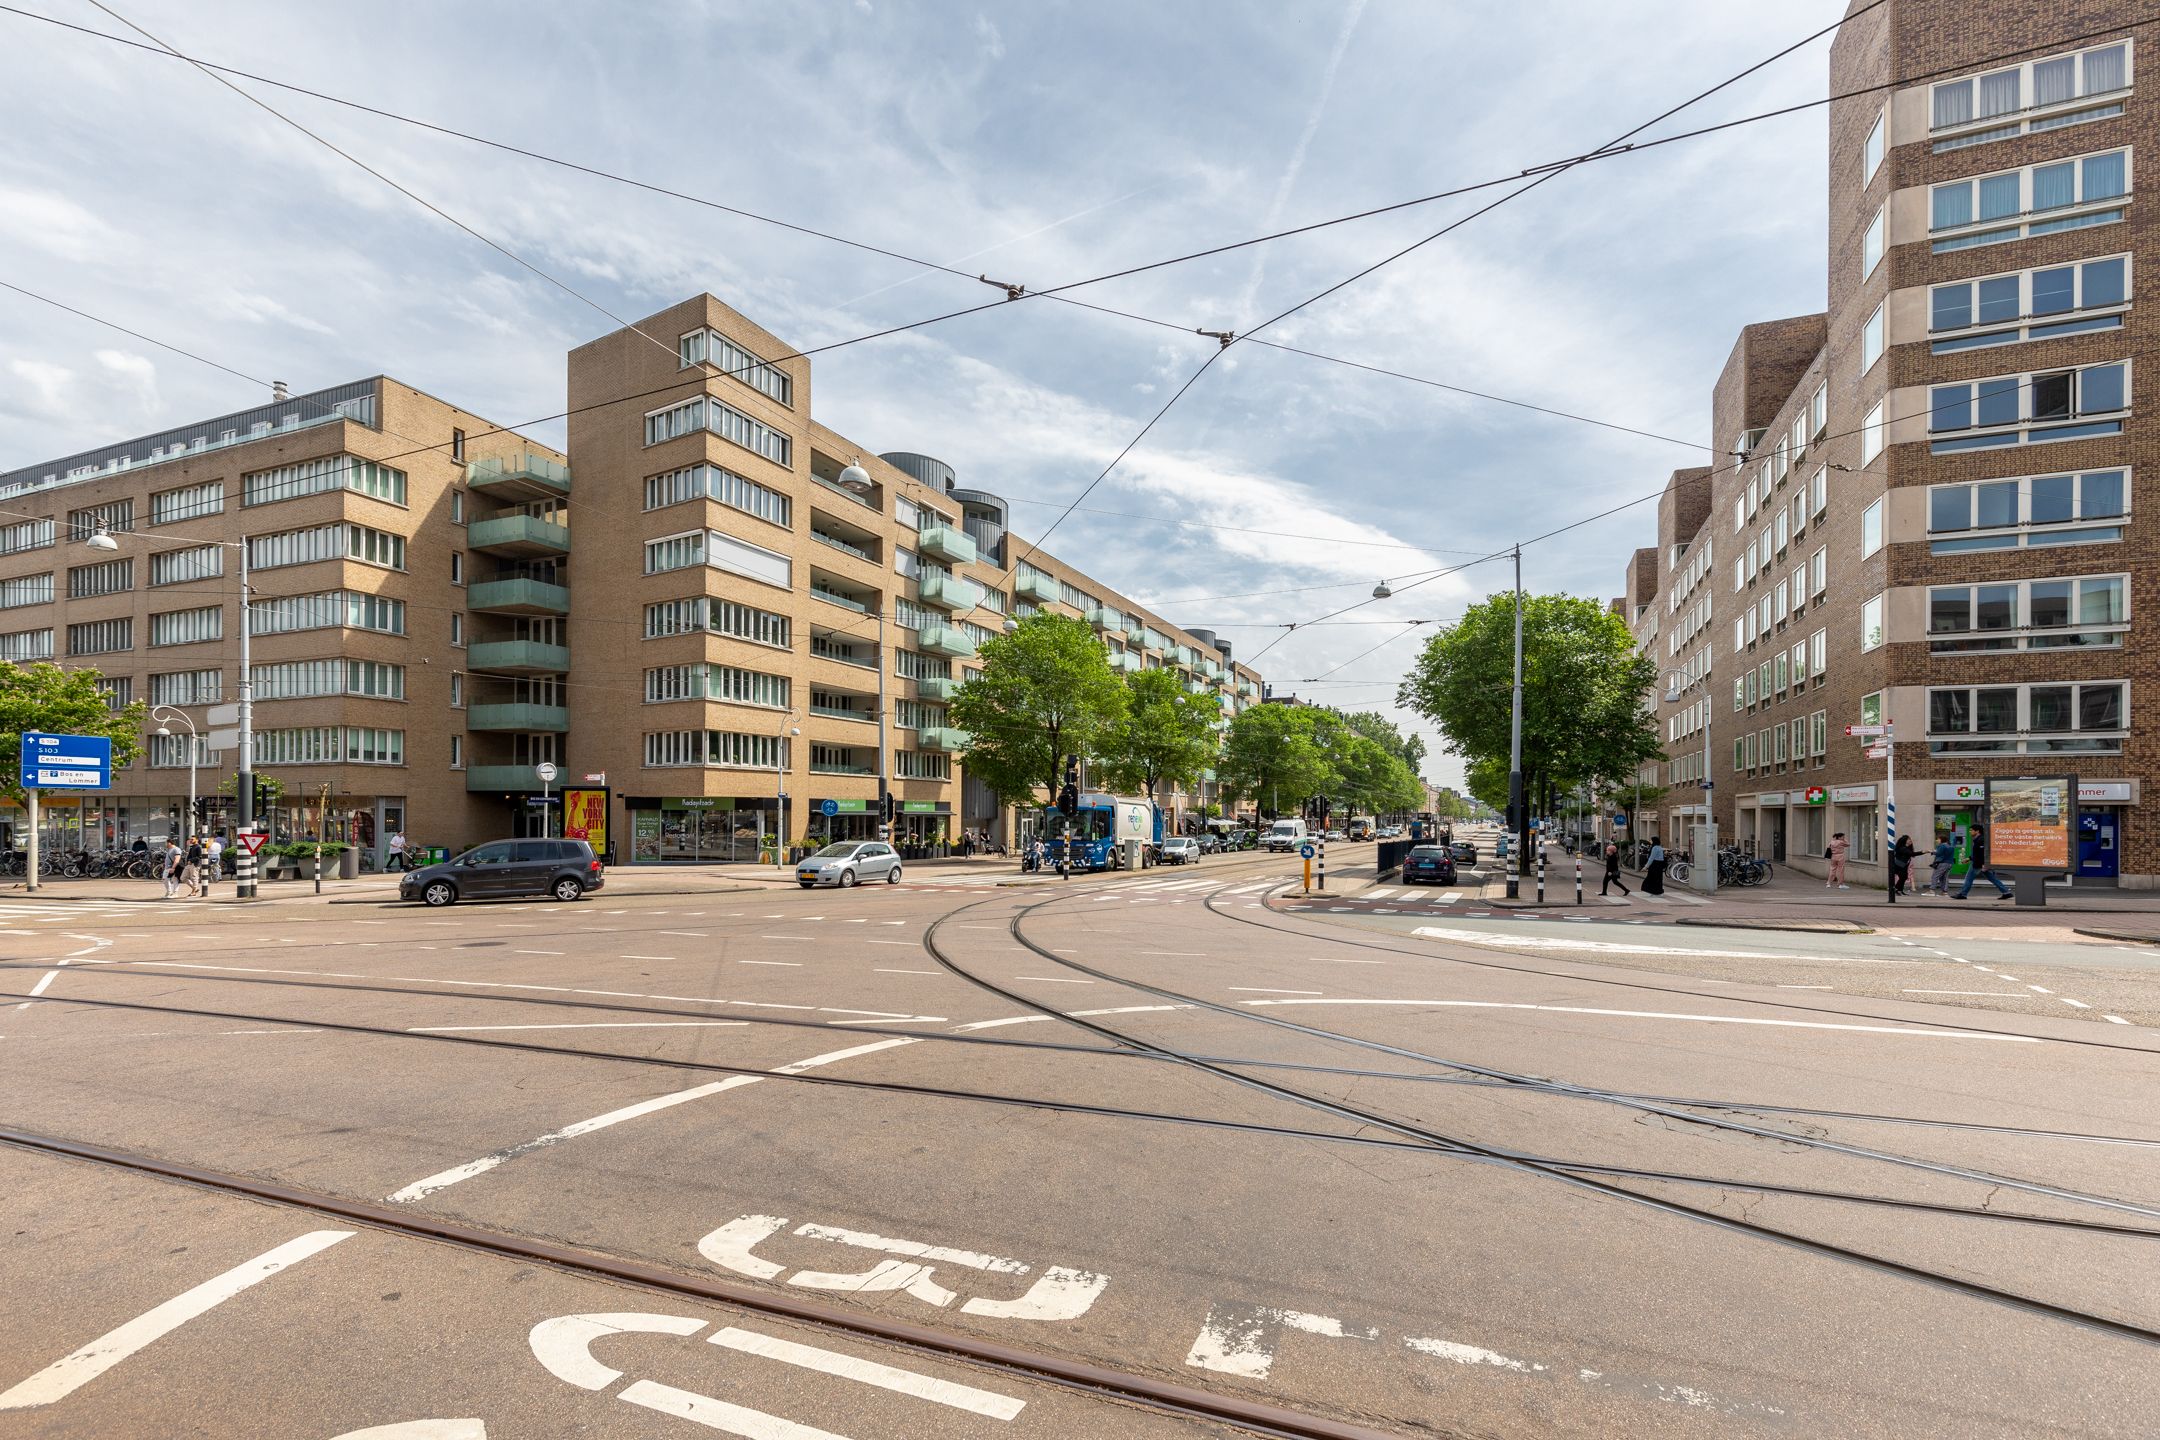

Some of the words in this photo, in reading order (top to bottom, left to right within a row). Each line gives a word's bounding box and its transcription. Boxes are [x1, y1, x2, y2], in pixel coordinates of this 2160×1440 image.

[588, 798, 604, 808] NEW
[583, 808, 604, 819] YORK
[587, 819, 604, 830] CITY
